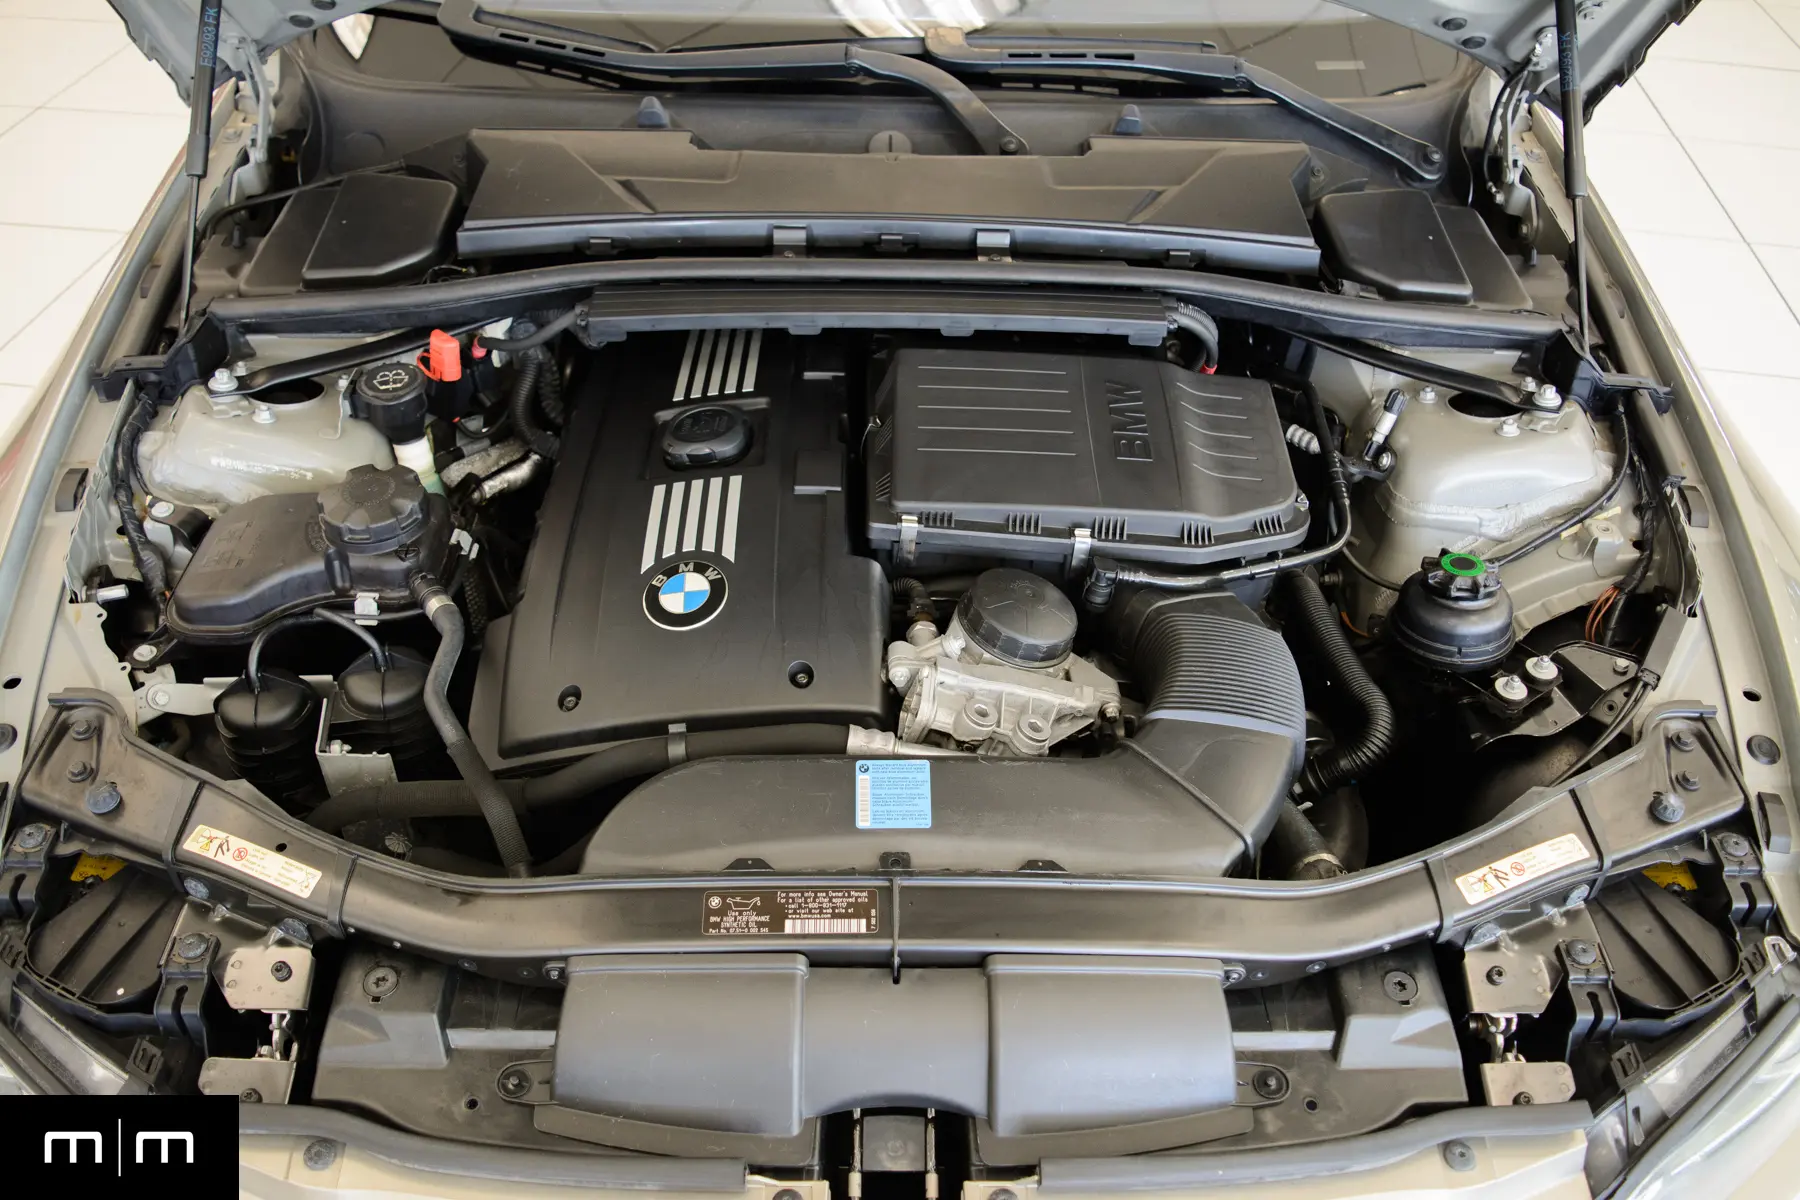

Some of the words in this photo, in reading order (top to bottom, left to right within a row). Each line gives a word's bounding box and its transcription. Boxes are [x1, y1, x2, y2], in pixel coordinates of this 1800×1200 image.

[205, 6, 219, 24] FK
[1105, 381, 1154, 462] BMW
[651, 562, 722, 588] BMW
[742, 909, 757, 917] only
